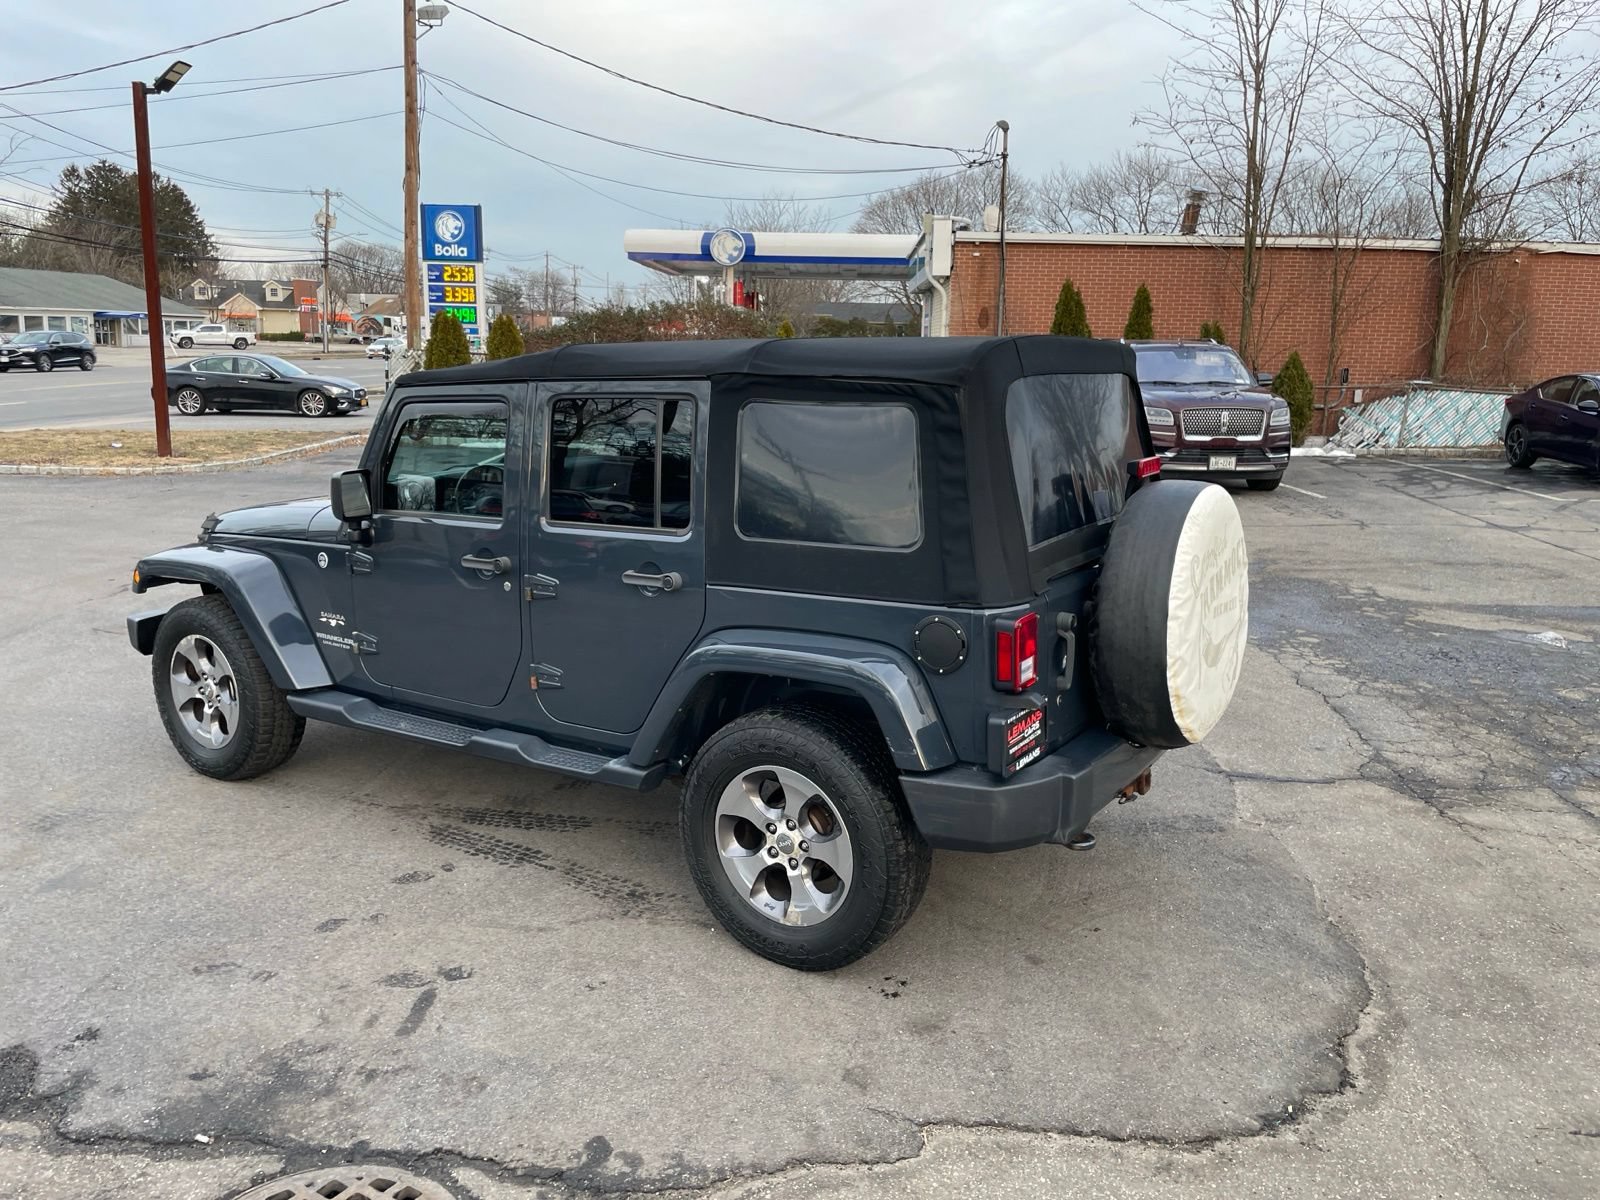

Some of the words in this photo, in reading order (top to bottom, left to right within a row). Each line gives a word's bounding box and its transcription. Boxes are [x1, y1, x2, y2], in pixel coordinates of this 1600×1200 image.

[435, 243, 467, 256] Bolla
[320, 611, 346, 621] SAHARA
[316, 631, 354, 646] WRANGLER
[323, 640, 350, 649] UNLIMITED
[1007, 710, 1043, 741] LEMANS
[1024, 720, 1040, 738] CARS
[1016, 747, 1040, 770] LEMANS
[776, 838, 793, 851] Jeep
